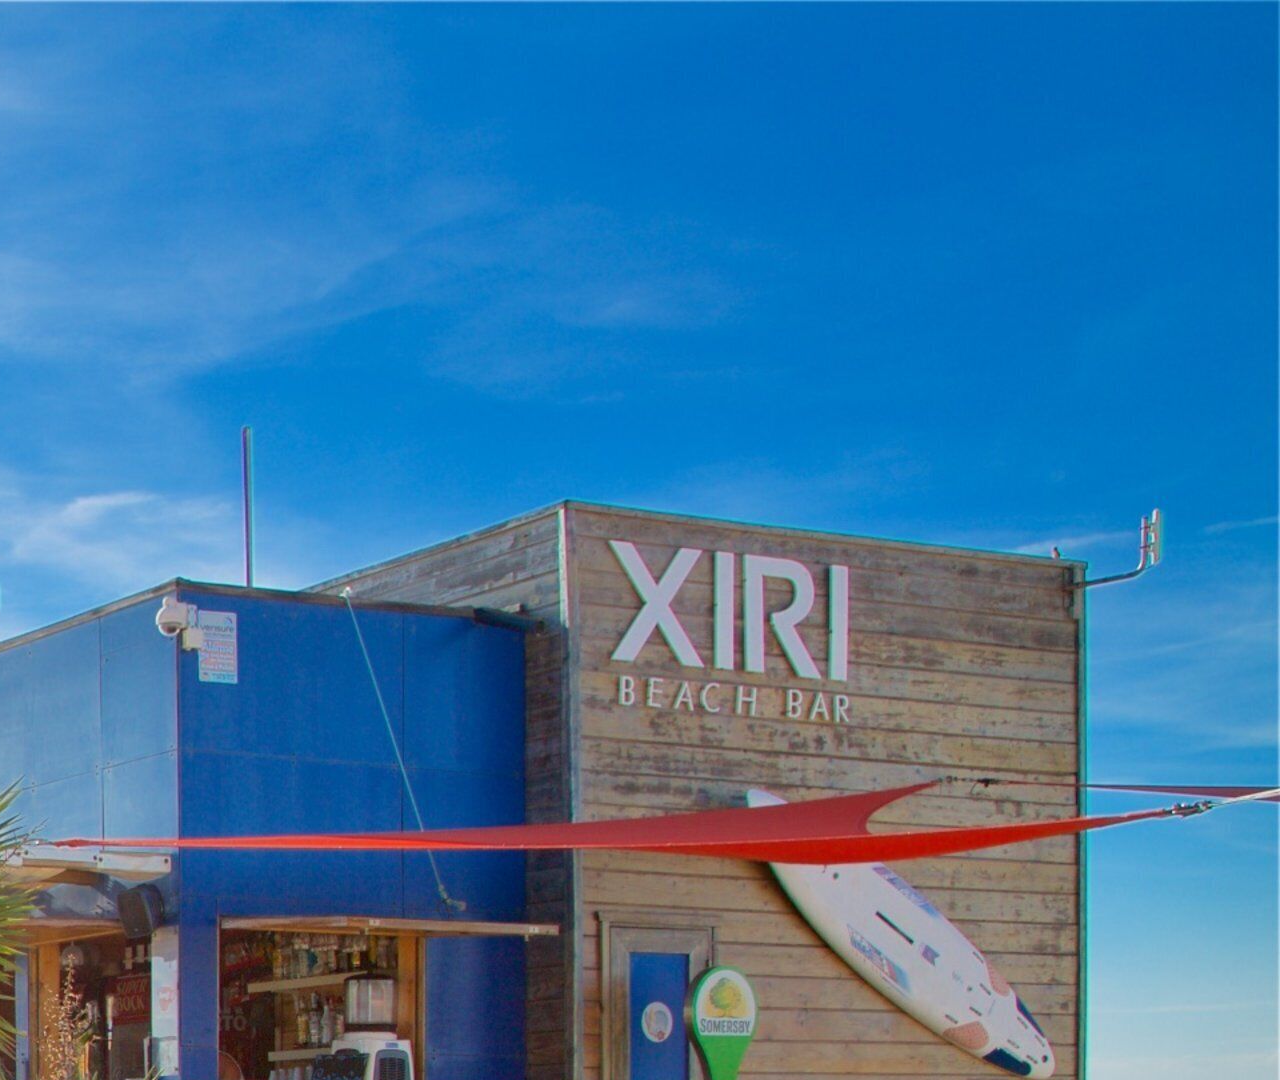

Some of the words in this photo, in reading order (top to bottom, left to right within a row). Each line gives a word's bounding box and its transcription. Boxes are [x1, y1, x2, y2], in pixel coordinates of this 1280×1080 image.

[608, 539, 849, 682] XIRI
[618, 674, 758, 717] BEACH
[786, 688, 850, 724] BAR
[117, 978, 147, 992] SUPER
[699, 1018, 751, 1033] SOMERSBY
